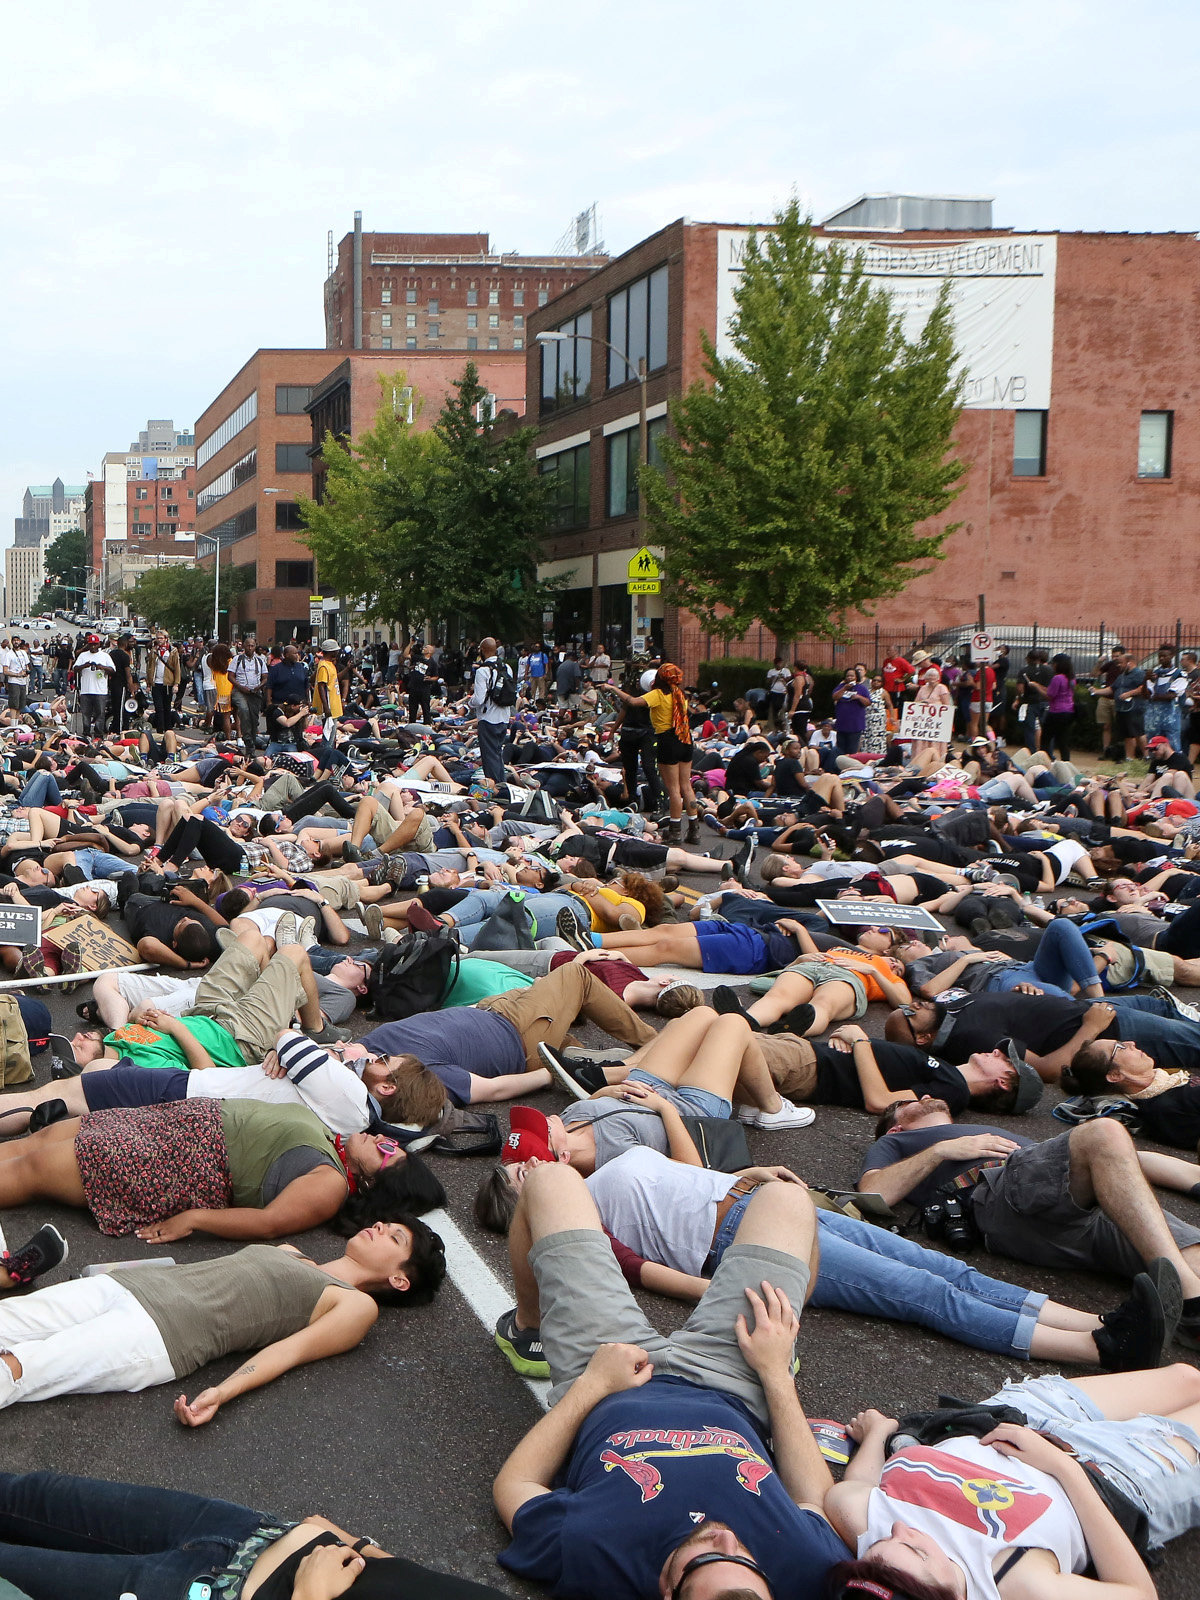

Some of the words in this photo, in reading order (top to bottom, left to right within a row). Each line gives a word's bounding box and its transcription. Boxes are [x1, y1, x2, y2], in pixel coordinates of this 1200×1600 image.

[924, 243, 1044, 272] DEVELOPMENT
[992, 376, 1027, 402] MB
[632, 583, 656, 591] AHEAD
[906, 702, 949, 718] STOP
[913, 721, 943, 730] BLACK
[905, 727, 940, 739] PEOPLE
[848, 910, 913, 920] MATTER
[878, 906, 924, 915] LIVES
[85, 938, 102, 951] BE
[86, 937, 133, 964] CANNOT
[605, 1425, 755, 1455] Cardinals
